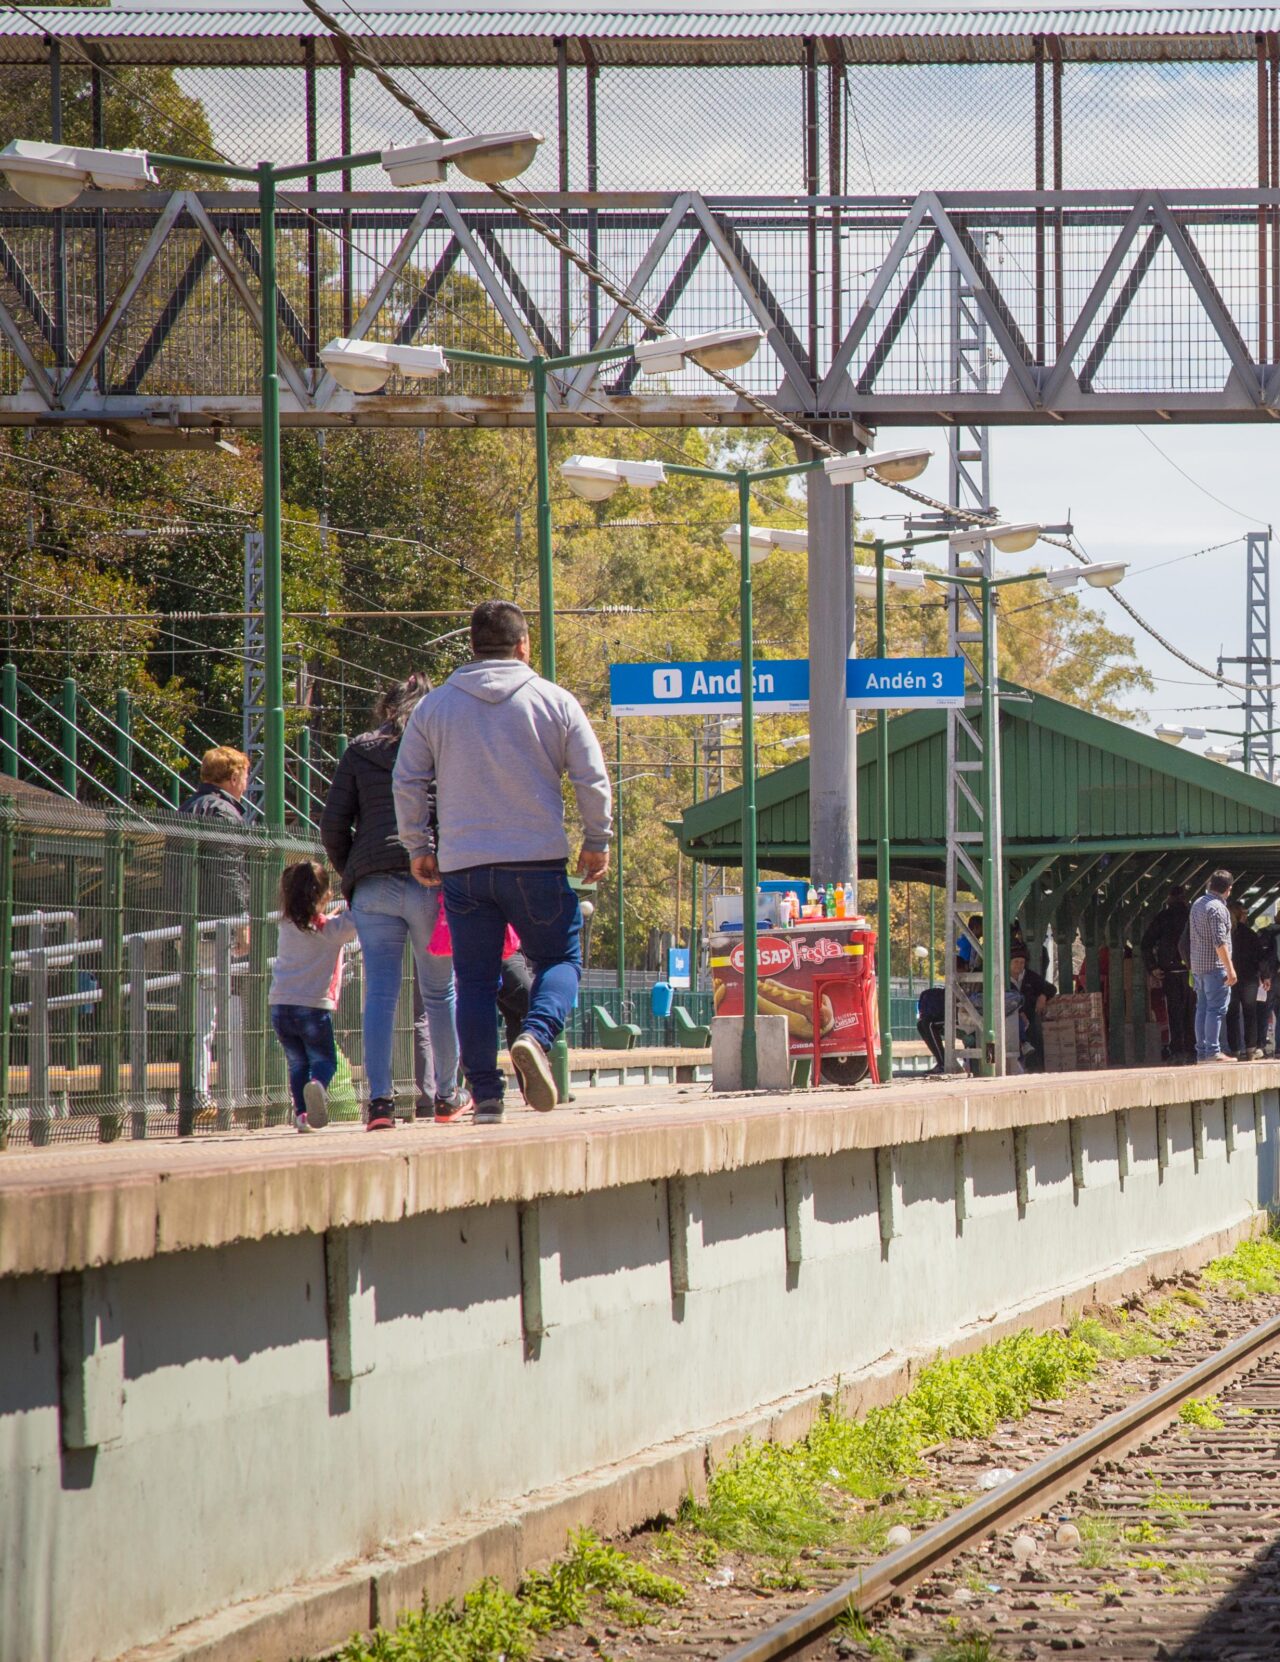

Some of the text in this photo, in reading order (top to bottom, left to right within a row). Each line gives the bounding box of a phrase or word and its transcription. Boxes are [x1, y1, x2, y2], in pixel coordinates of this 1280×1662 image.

[663, 675, 671, 692] 1
[865, 671, 943, 689] Andén 3
[791, 938, 842, 970] Fiesta
